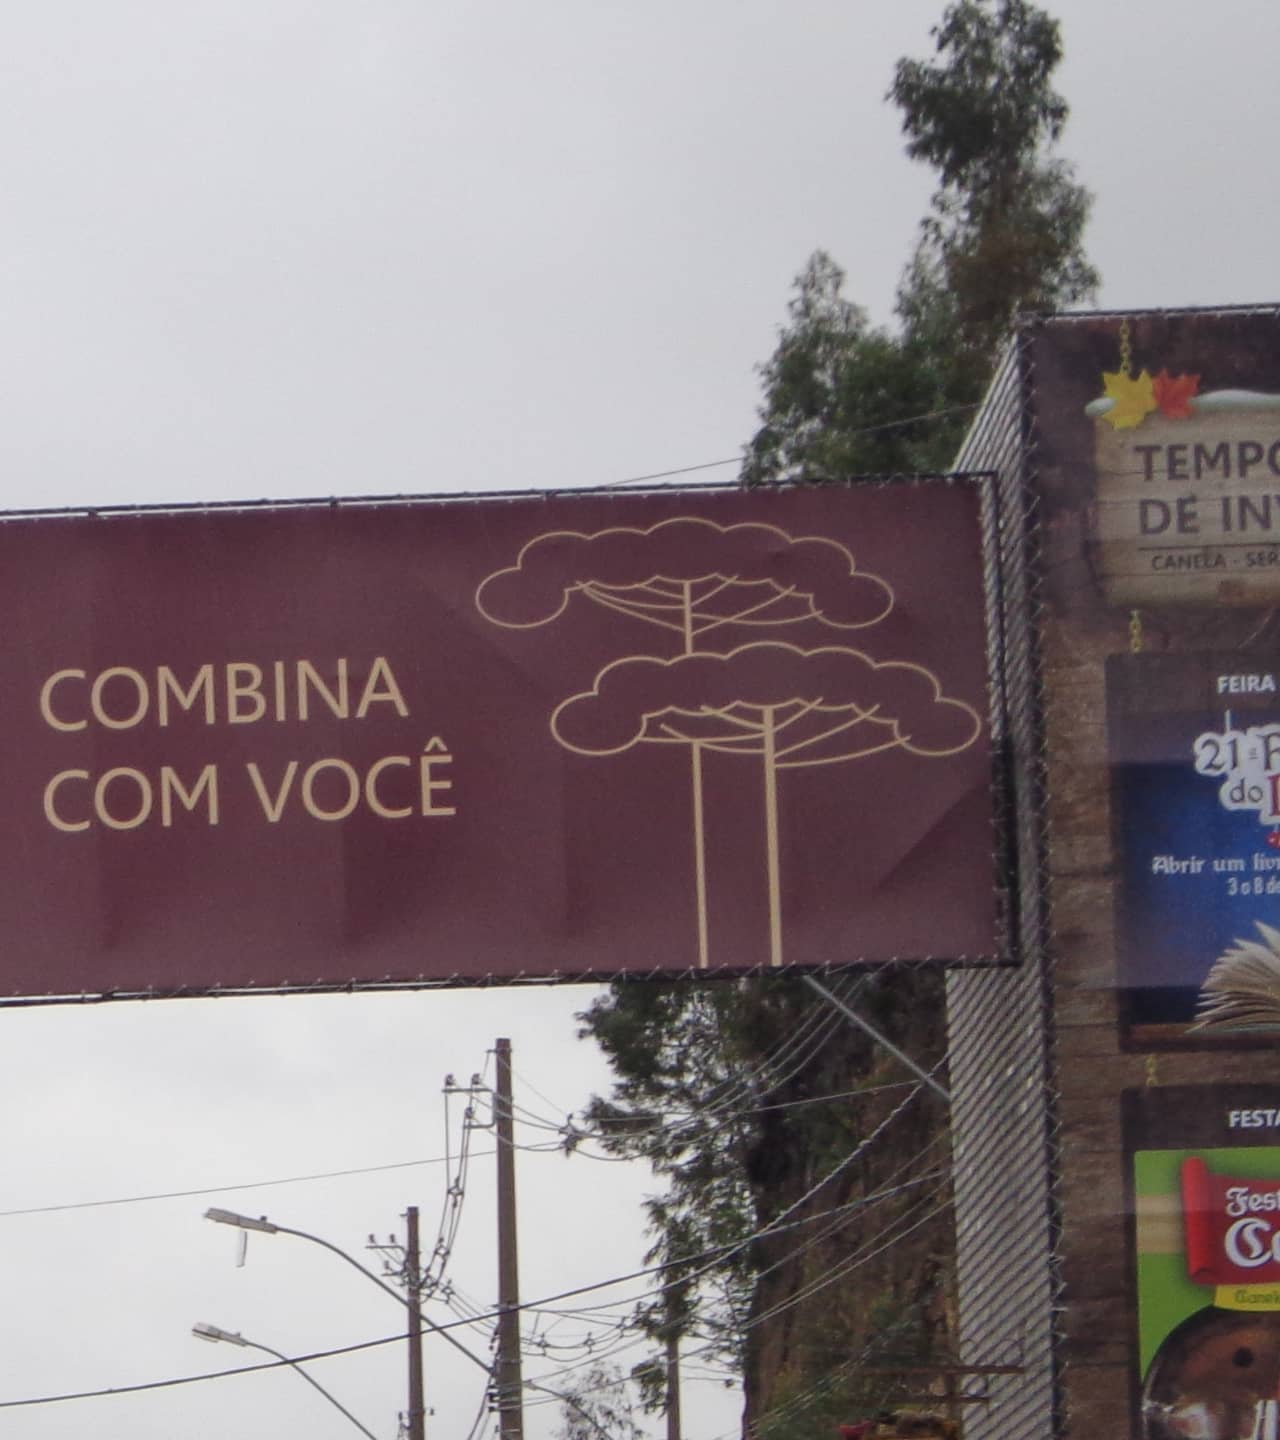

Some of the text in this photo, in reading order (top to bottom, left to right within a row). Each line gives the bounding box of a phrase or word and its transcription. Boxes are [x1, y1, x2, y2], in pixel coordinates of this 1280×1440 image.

[1140, 495, 1280, 534] DE IN
[1152, 554, 1226, 571] CANELA
[41, 656, 409, 732] COMBINA
[1218, 675, 1276, 693] FEIRA
[44, 736, 457, 832] COM VOCÊ
[1231, 776, 1263, 803] do
[1152, 854, 1206, 874] Abrir
[1213, 858, 1245, 872] um
